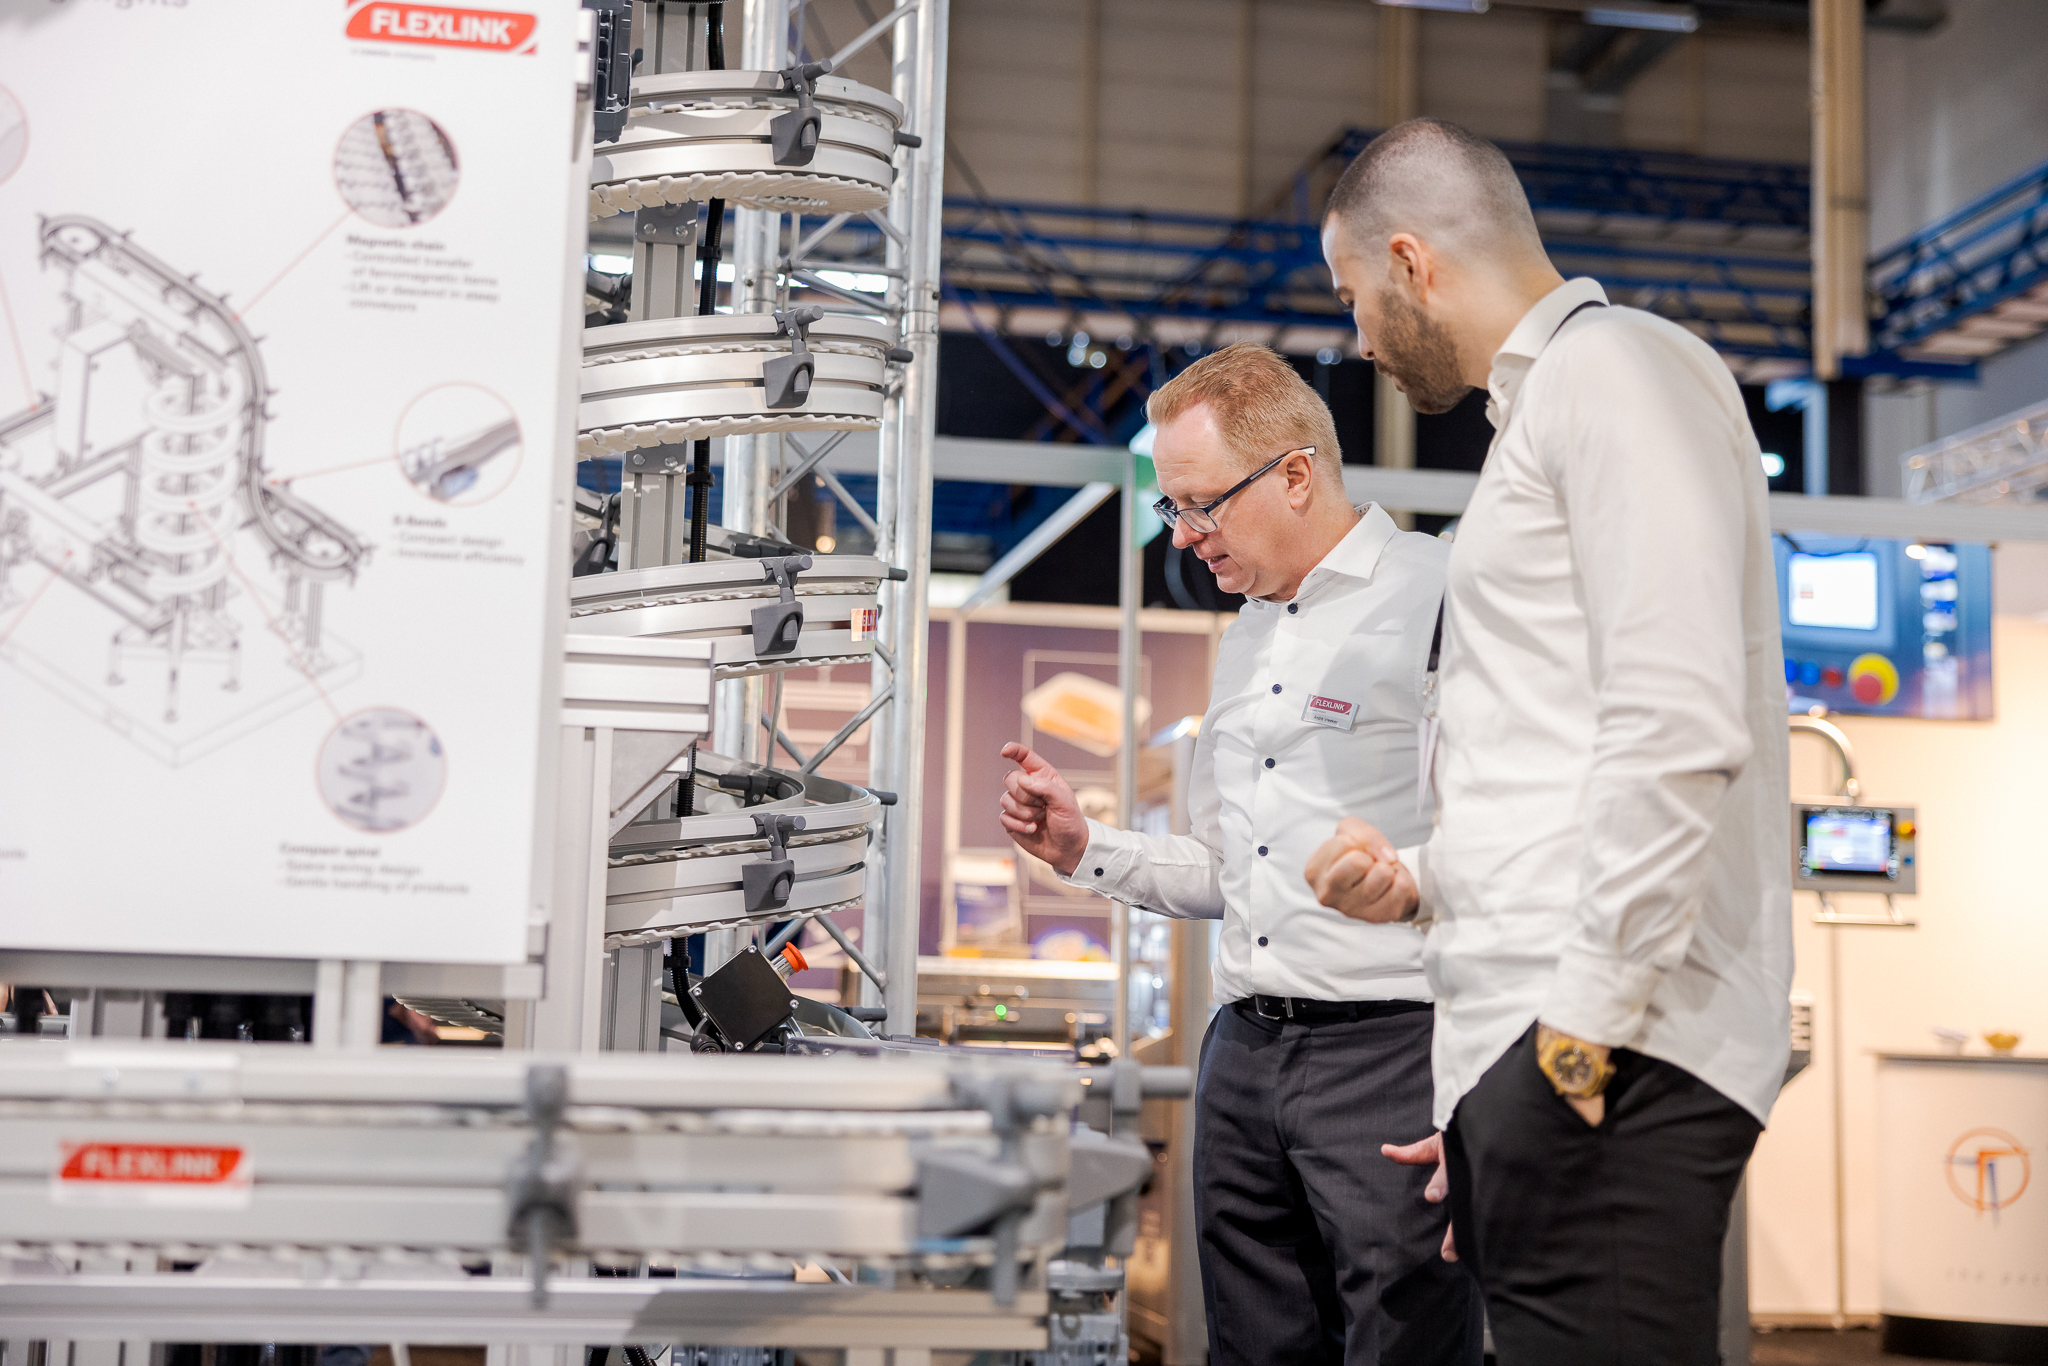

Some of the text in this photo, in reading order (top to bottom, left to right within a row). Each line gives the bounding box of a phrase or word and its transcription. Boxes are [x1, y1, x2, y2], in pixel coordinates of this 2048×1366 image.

[370, 7, 512, 45] FLEXLINK
[347, 235, 445, 251] Magnetic chain
[353, 251, 472, 268] Controlled transfer
[399, 532, 504, 550] Compact design
[398, 547, 461, 560] Increased
[1315, 699, 1345, 711] FLEXLINK
[280, 843, 341, 856] Compact
